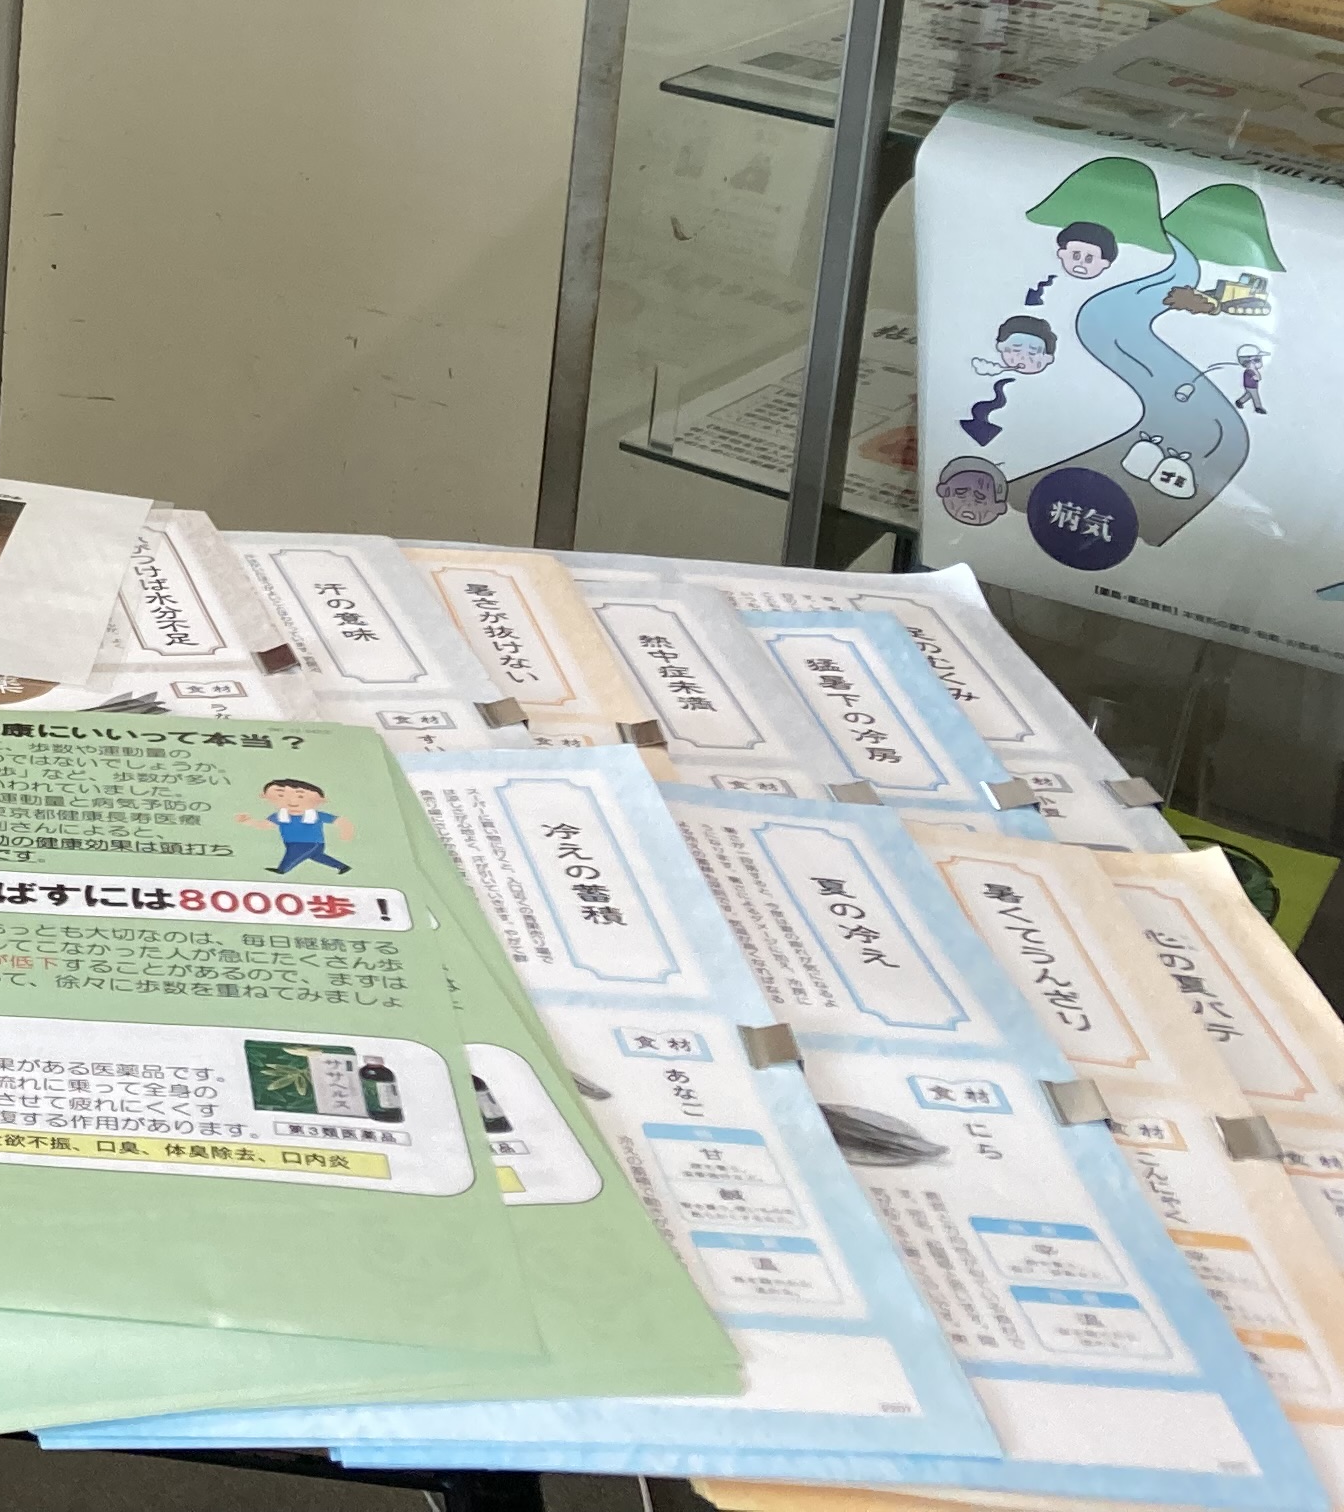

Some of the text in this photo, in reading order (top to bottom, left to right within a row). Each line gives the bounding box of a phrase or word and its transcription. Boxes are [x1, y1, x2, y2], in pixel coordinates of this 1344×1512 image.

[1048, 498, 1114, 545] 病気
[311, 580, 381, 645] 汗の意味
[804, 656, 903, 766] 猛暑下の冷房
[541, 821, 628, 928] 冷えの蓄積
[810, 877, 900, 970] 夏の冷え
